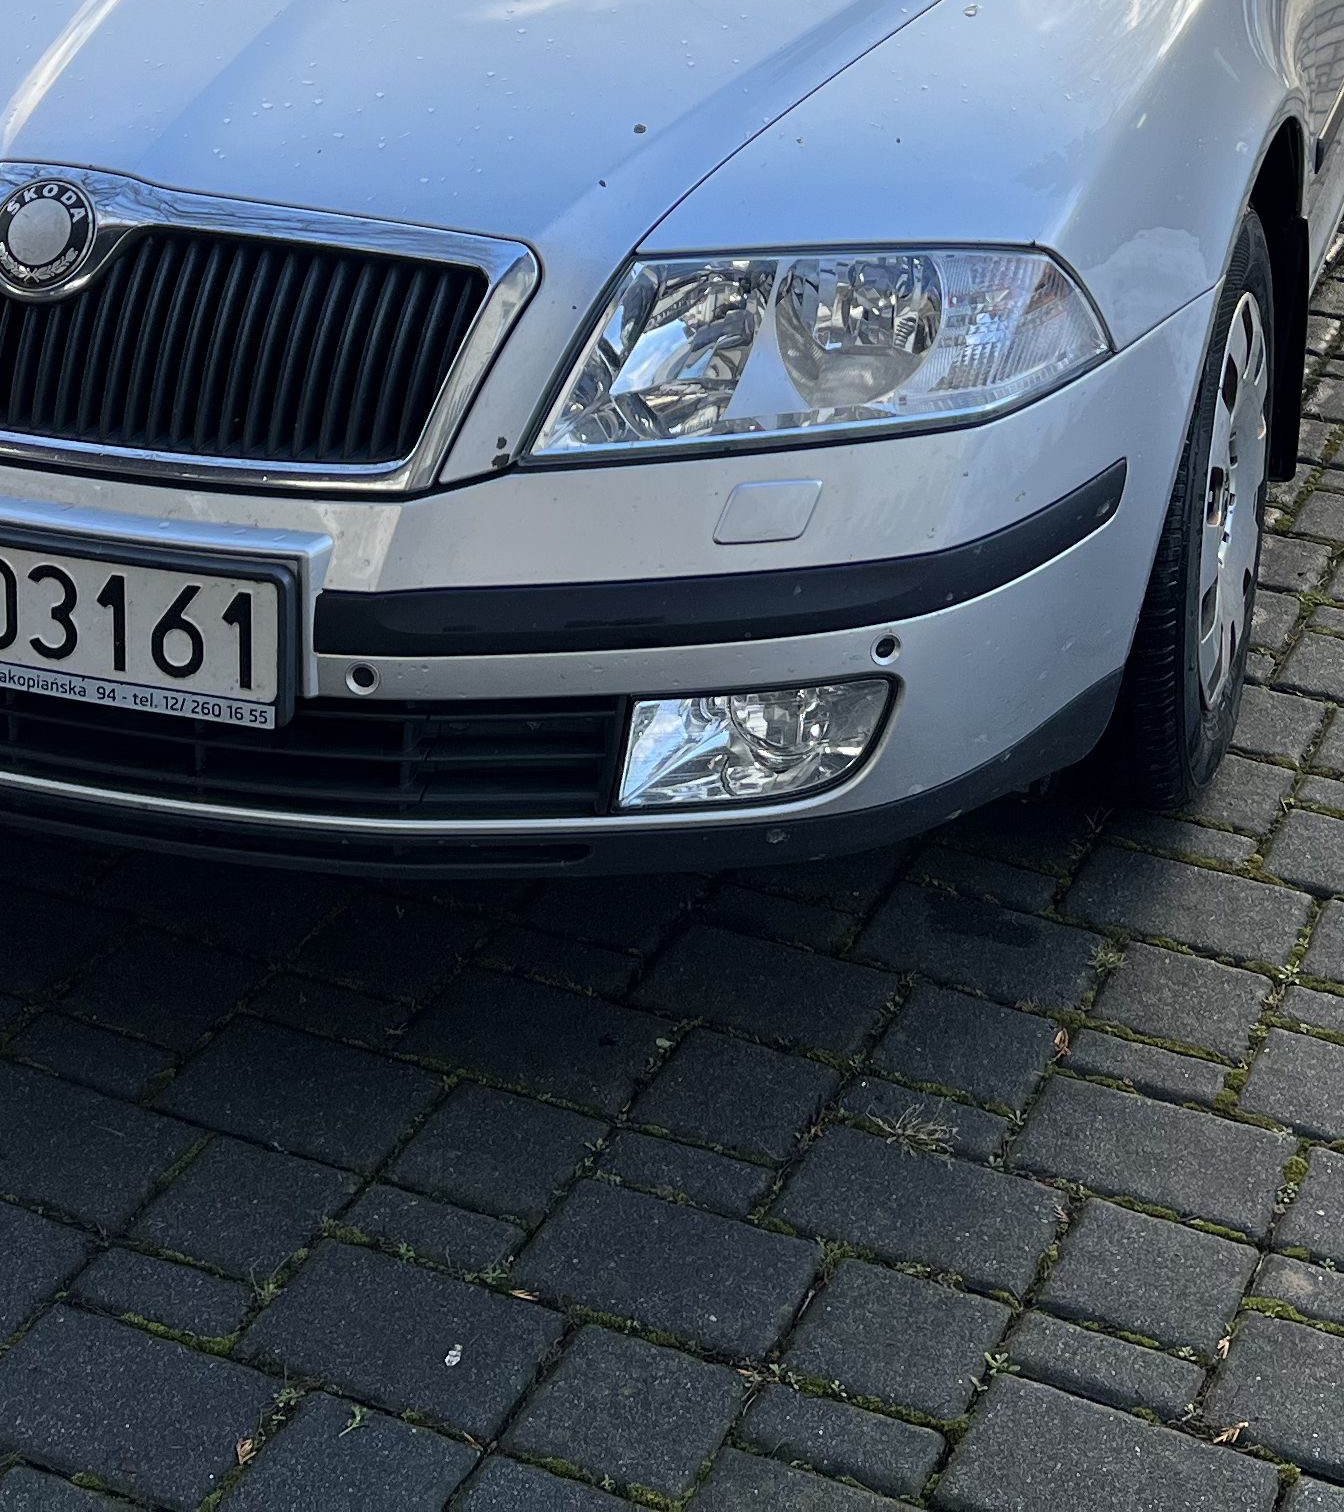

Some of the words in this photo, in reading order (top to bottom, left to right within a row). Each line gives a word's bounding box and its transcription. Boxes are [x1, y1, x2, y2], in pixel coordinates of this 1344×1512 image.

[96, 686, 117, 702] 94
[133, 692, 158, 709] tel.
[191, 699, 222, 719] 260
[227, 705, 244, 721] 16
[249, 709, 268, 725] 55
